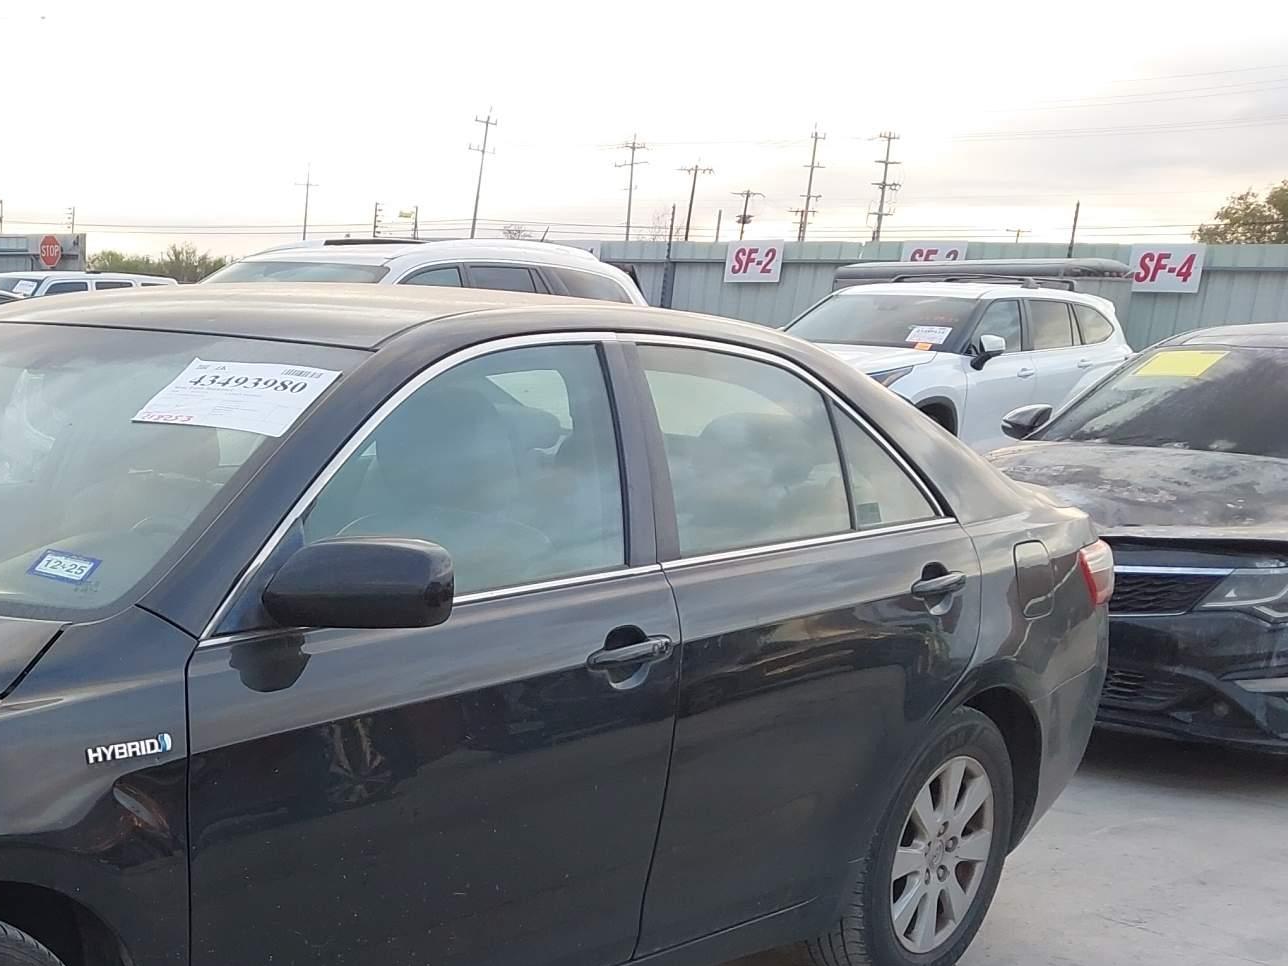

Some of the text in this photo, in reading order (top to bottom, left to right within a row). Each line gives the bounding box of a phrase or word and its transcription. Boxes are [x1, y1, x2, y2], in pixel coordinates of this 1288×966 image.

[41, 245, 59, 256] STOP
[731, 247, 777, 274] SF-2
[1135, 252, 1197, 283] SF-4
[189, 373, 308, 394] 43493980
[87, 738, 162, 763] HYBRID
